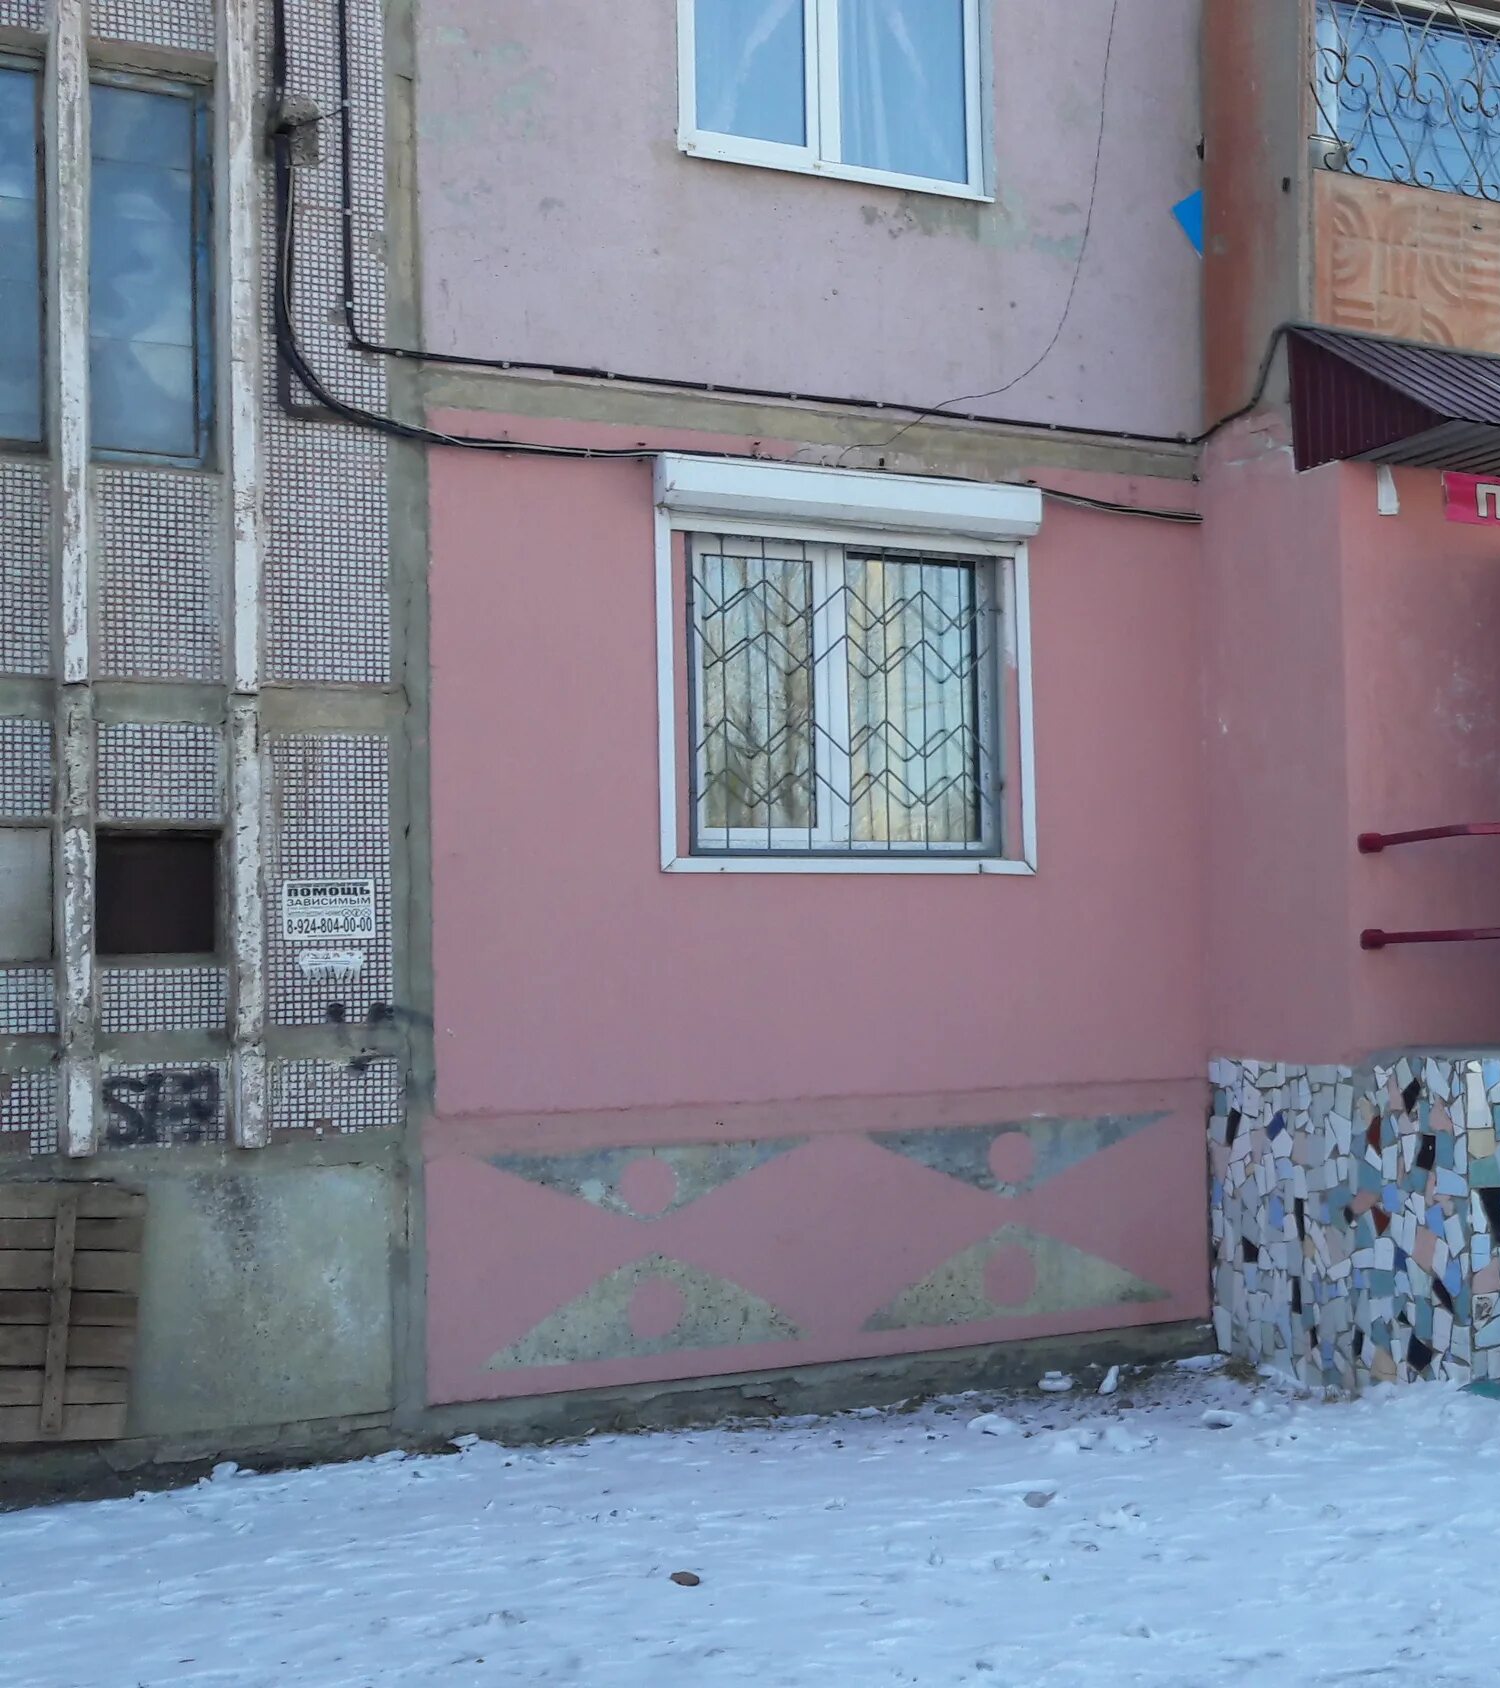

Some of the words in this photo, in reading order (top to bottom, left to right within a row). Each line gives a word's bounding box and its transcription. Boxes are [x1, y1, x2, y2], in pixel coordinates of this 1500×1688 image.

[286, 886, 371, 897] ПОМОЩЬ
[286, 897, 371, 907] ЗАВИСИМЫМ
[286, 917, 372, 934] 8-924-804-00-00
